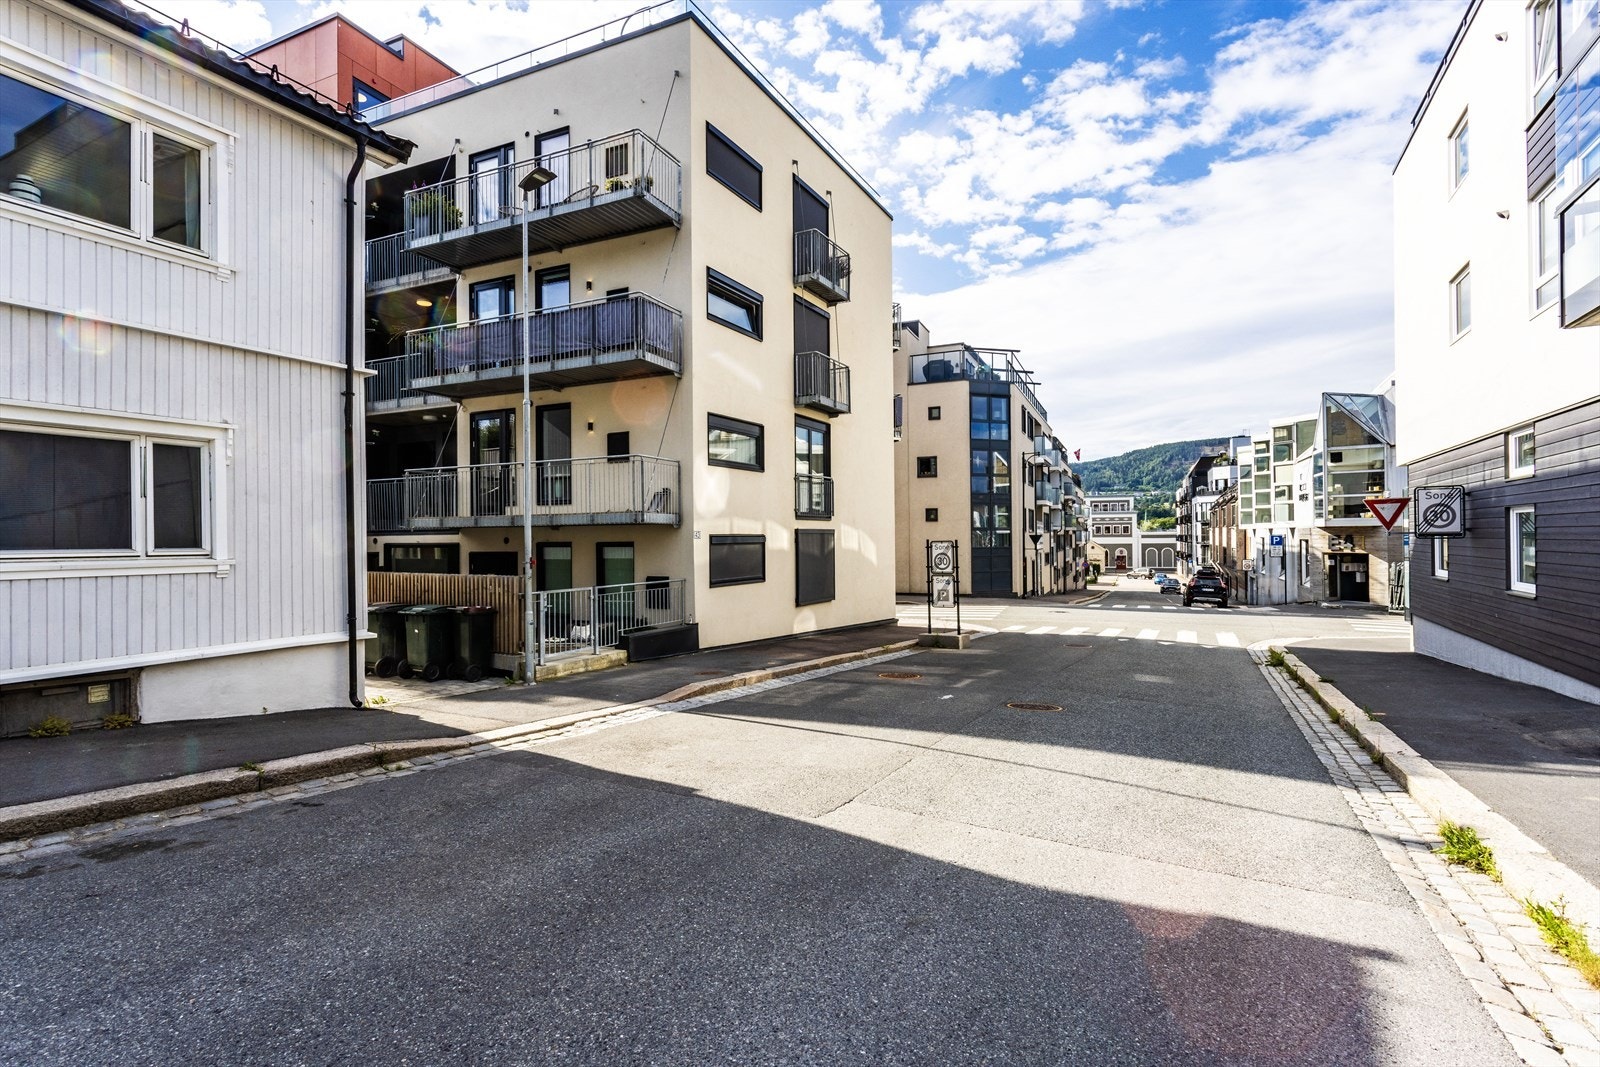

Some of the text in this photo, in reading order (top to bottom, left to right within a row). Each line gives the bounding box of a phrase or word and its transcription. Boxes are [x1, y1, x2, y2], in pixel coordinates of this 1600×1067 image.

[1273, 536, 1280, 545] P
[937, 556, 948, 566] 30
[940, 590, 947, 600] P
